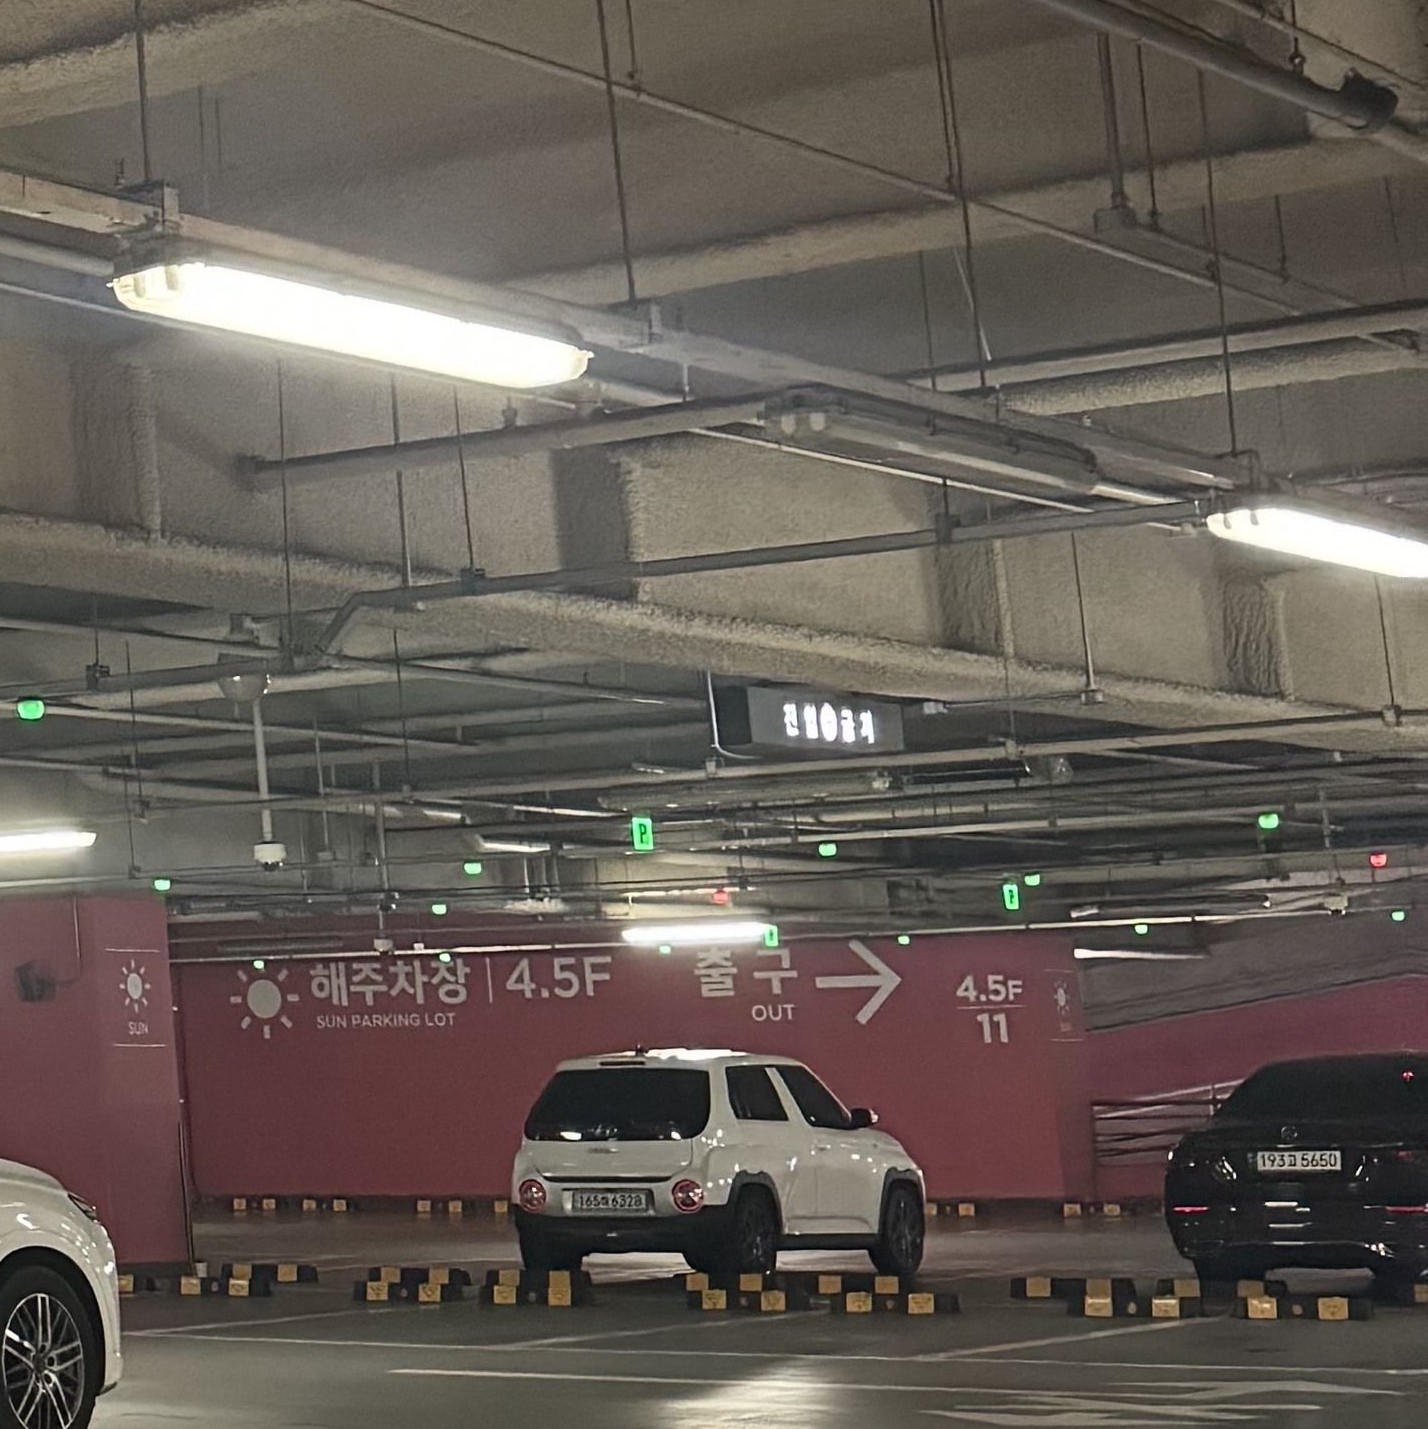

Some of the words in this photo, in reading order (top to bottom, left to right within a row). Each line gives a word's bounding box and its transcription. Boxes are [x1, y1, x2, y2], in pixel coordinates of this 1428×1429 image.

[309, 958, 470, 1006] 해주차장
[505, 955, 612, 999] 4.5F
[955, 974, 1023, 1003] 4.5F
[316, 1014, 346, 1029] SUN
[351, 1013, 421, 1027] PARKING
[424, 1012, 456, 1027] LOT
[751, 1004, 795, 1021] OUT
[976, 1012, 1008, 1043] 11
[1301, 1152, 1337, 1168] 5650
